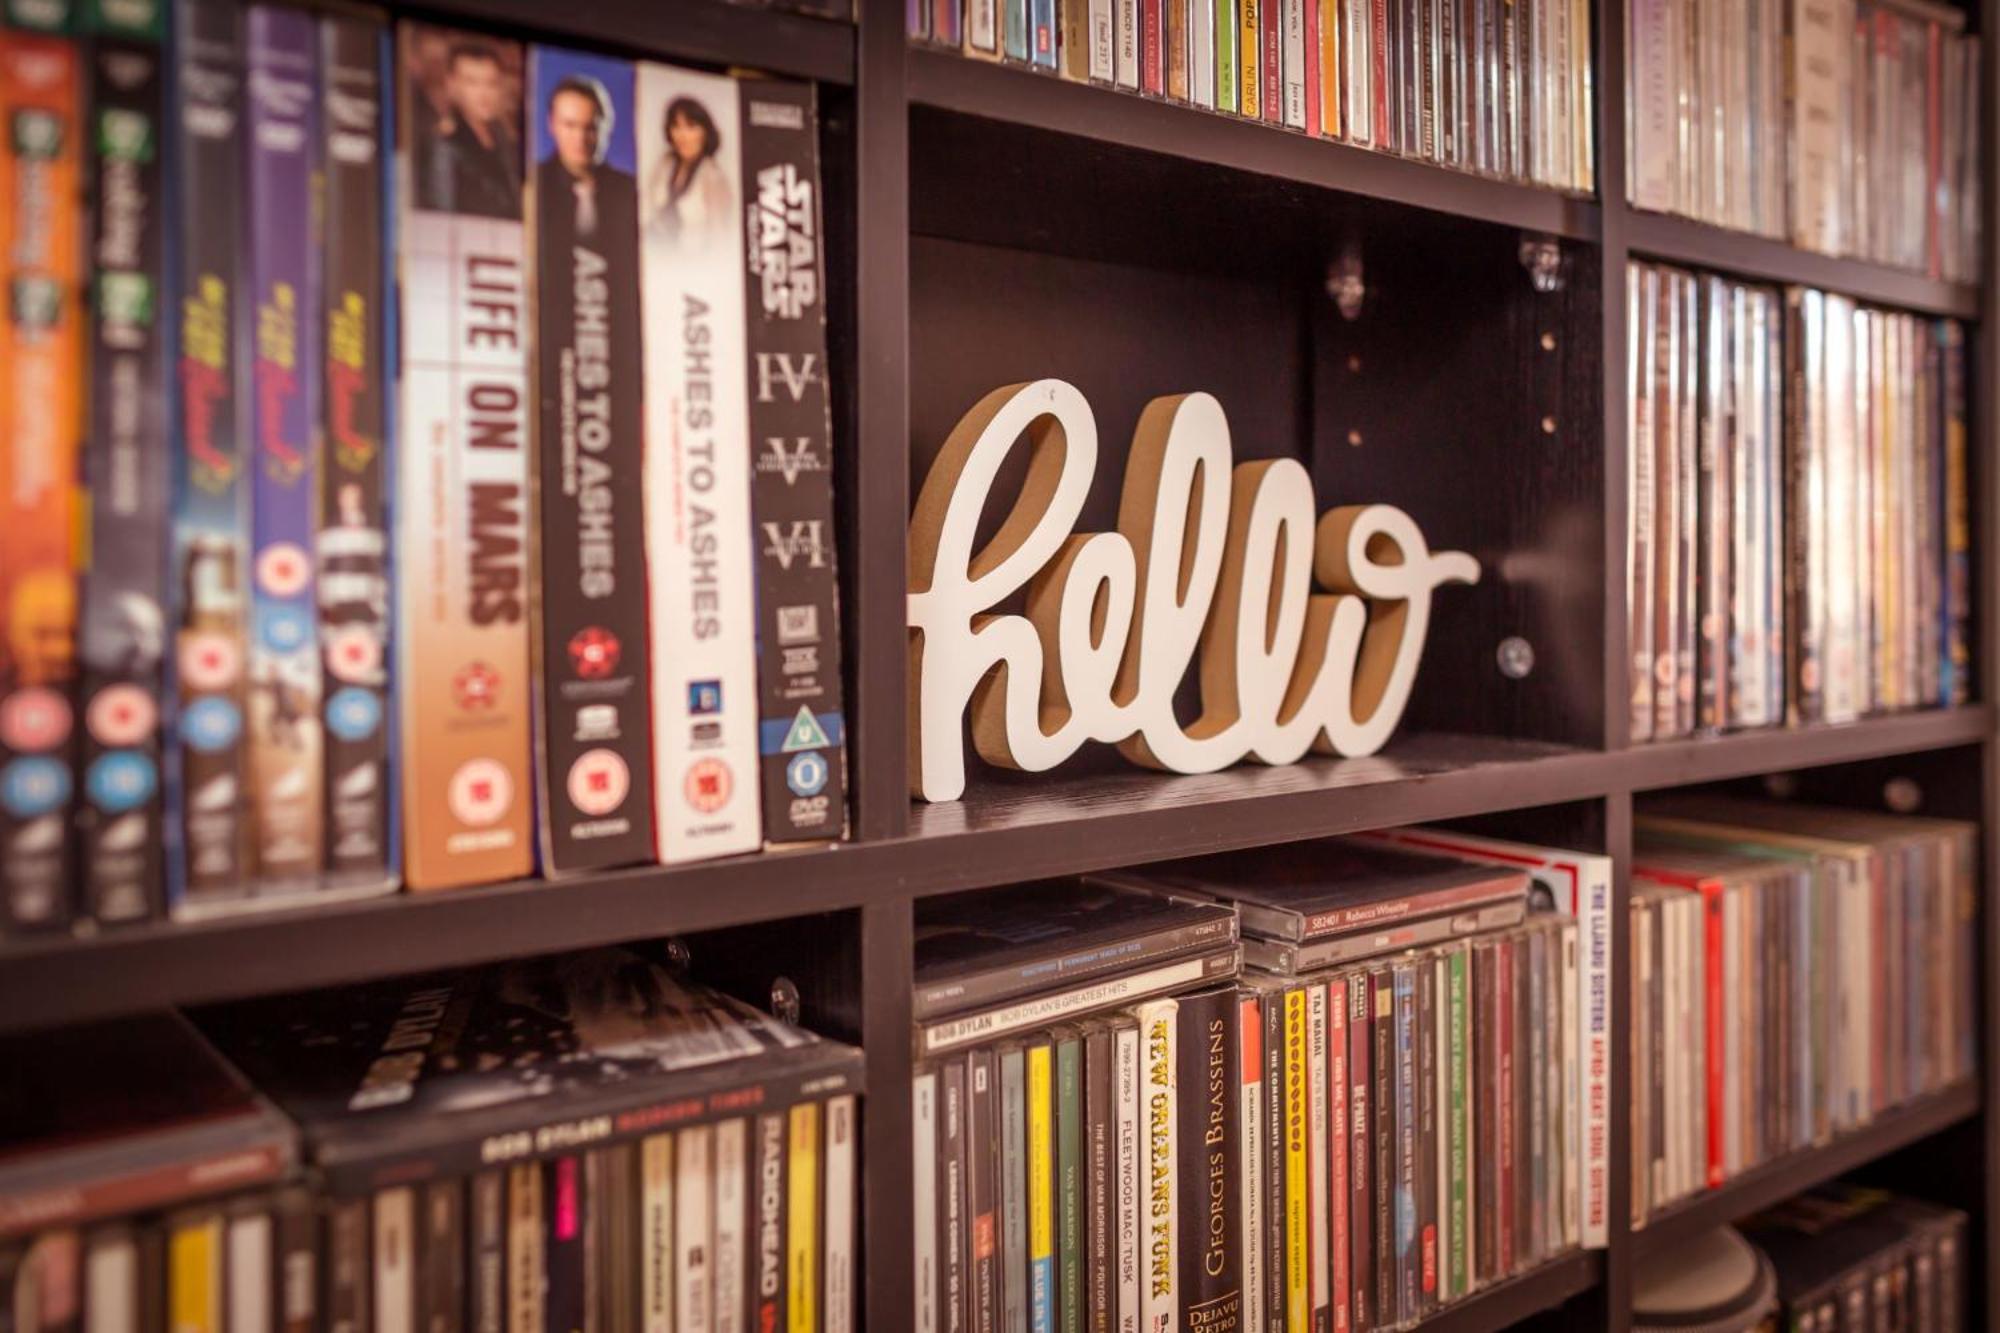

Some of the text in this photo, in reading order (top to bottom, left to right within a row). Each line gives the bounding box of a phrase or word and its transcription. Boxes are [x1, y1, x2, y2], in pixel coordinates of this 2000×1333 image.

[1245, 65, 1257, 115] CARLIN
[755, 163, 817, 320] STAR WARS
[755, 352, 817, 402] IV
[465, 255, 523, 628] LIFE ON MARS
[573, 246, 616, 599] ASHES TO ASHES
[680, 292, 723, 642] ASHES TO ASHES
[765, 436, 811, 486] V
[761, 519, 827, 571] VI
[906, 377, 1482, 804] hello
[1590, 883, 1606, 912] THE
[934, 1026, 957, 1042] BOB
[958, 1015, 993, 1036] DYLAN
[1000, 1010, 1023, 1025] BOB
[1061, 988, 1108, 1009] GREATEST
[1107, 982, 1128, 996] HITS
[1313, 993, 1322, 1015] TAJ
[1451, 975, 1462, 1001] THE
[1590, 973, 1606, 1034] SISTERS
[1270, 1049, 1278, 1069] THE
[1313, 1019, 1322, 1059] MAHAL
[1334, 1056, 1344, 1083] KISS
[535, 1115, 613, 1152] DYLAN
[709, 1085, 766, 1112] TIMES
[1096, 1123, 1105, 1141] THE
[1271, 1071, 1279, 1147] COMMITMENTS
[1334, 1108, 1345, 1136] KATE
[1096, 1143, 1105, 1167] BEST
[1122, 1120, 1133, 1205] FLEETWOOD
[1150, 1019, 1173, 1301] NEW ORLEANS FUNK
[1589, 1124, 1605, 1161] SOUL
[948, 1160, 958, 1220] LEONARD
[1066, 1164, 1075, 1190] VAN
[1096, 1169, 1105, 1182] OF
[1096, 1183, 1105, 1204] VAN
[1588, 1166, 1605, 1228] SISTERS
[760, 1116, 783, 1297] RADIOHEAD
[1066, 1191, 1076, 1250] MORRISON
[1096, 1205, 1106, 1258] MORRISON
[1123, 1209, 1133, 1239] MAC
[949, 1220, 958, 1264] COHEN
[1123, 1246, 1134, 1284] TUSK
[1033, 1263, 1046, 1303] BLUE
[1097, 1266, 1107, 1311] POLYDOR
